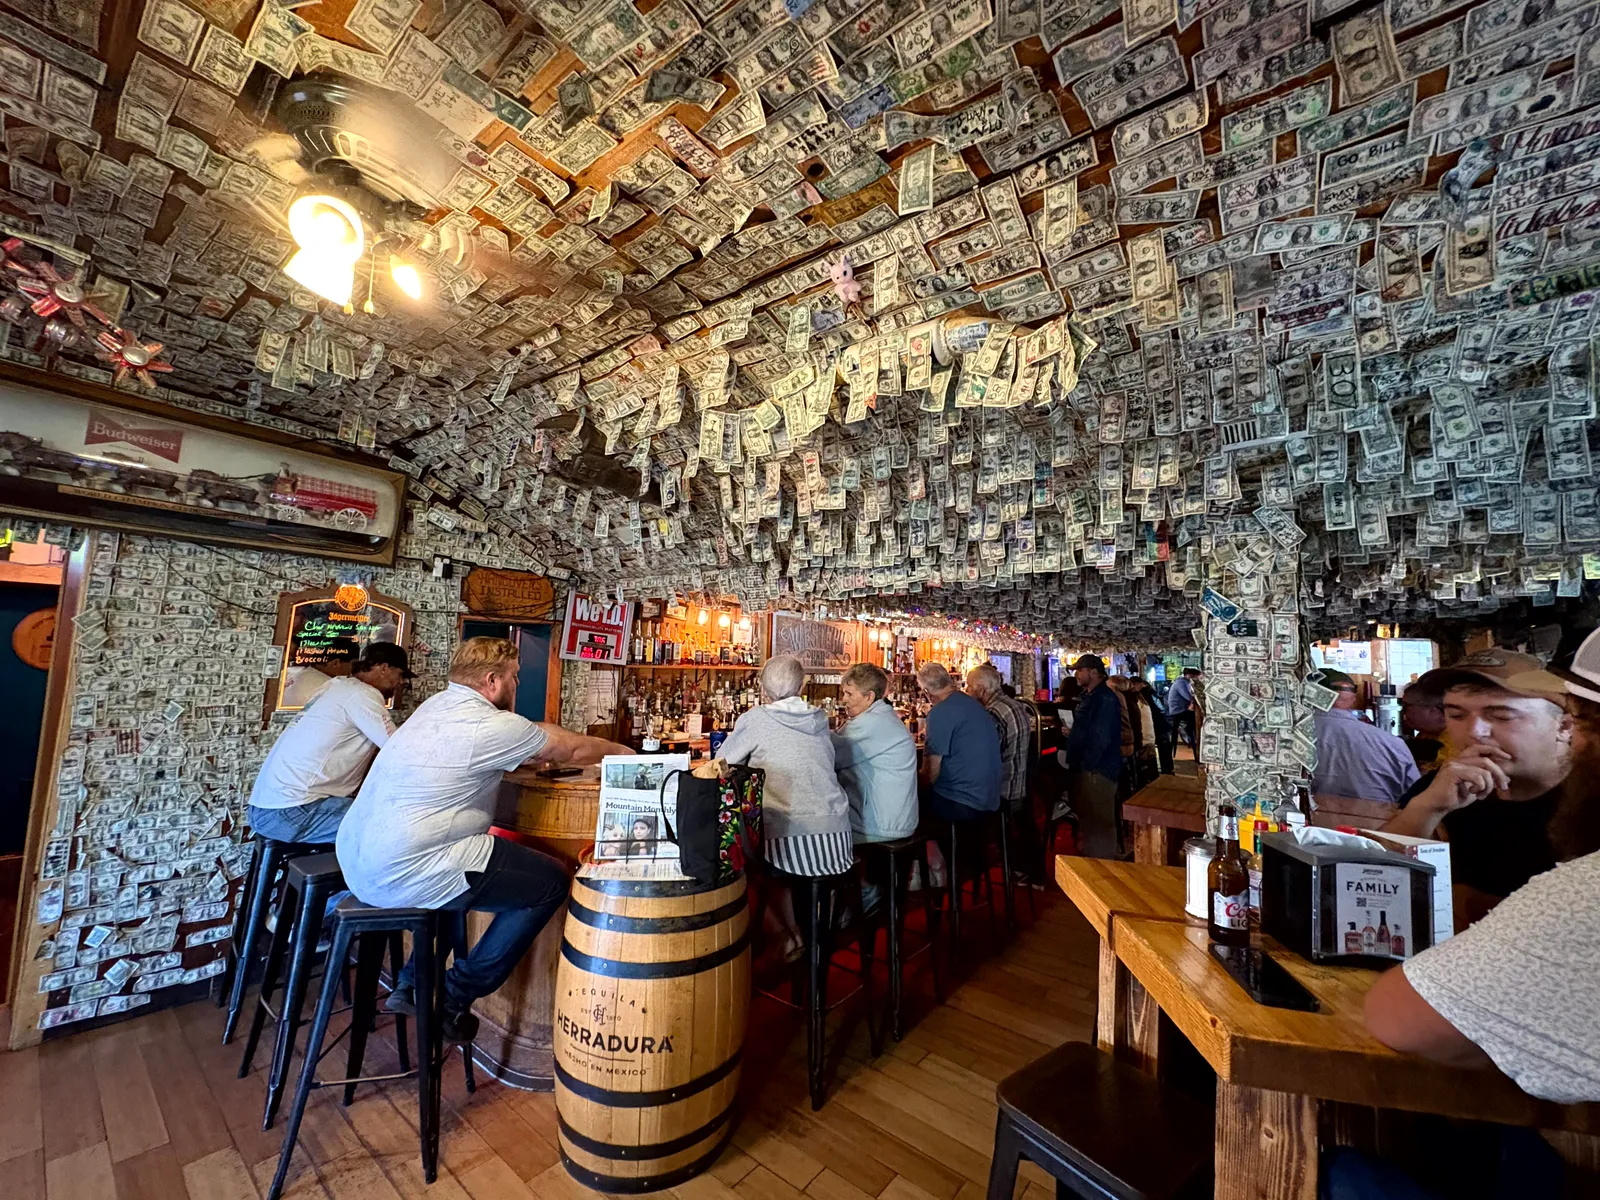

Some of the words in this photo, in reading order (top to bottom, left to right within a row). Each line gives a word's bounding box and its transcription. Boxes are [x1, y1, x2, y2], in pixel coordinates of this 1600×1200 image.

[1337, 153, 1359, 167] GO
[91, 420, 177, 451] Budweiser
[480, 585, 542, 601] INSTALLED
[575, 597, 601, 623] We
[295, 655, 329, 665] Broccoli
[605, 801, 643, 812] Mountain
[643, 805, 677, 816] Monhly
[1346, 881, 1400, 895] FAMILY
[556, 1008, 674, 1054] HERRADURA
[563, 1047, 588, 1068] HECHO
[590, 1063, 602, 1073] EN
